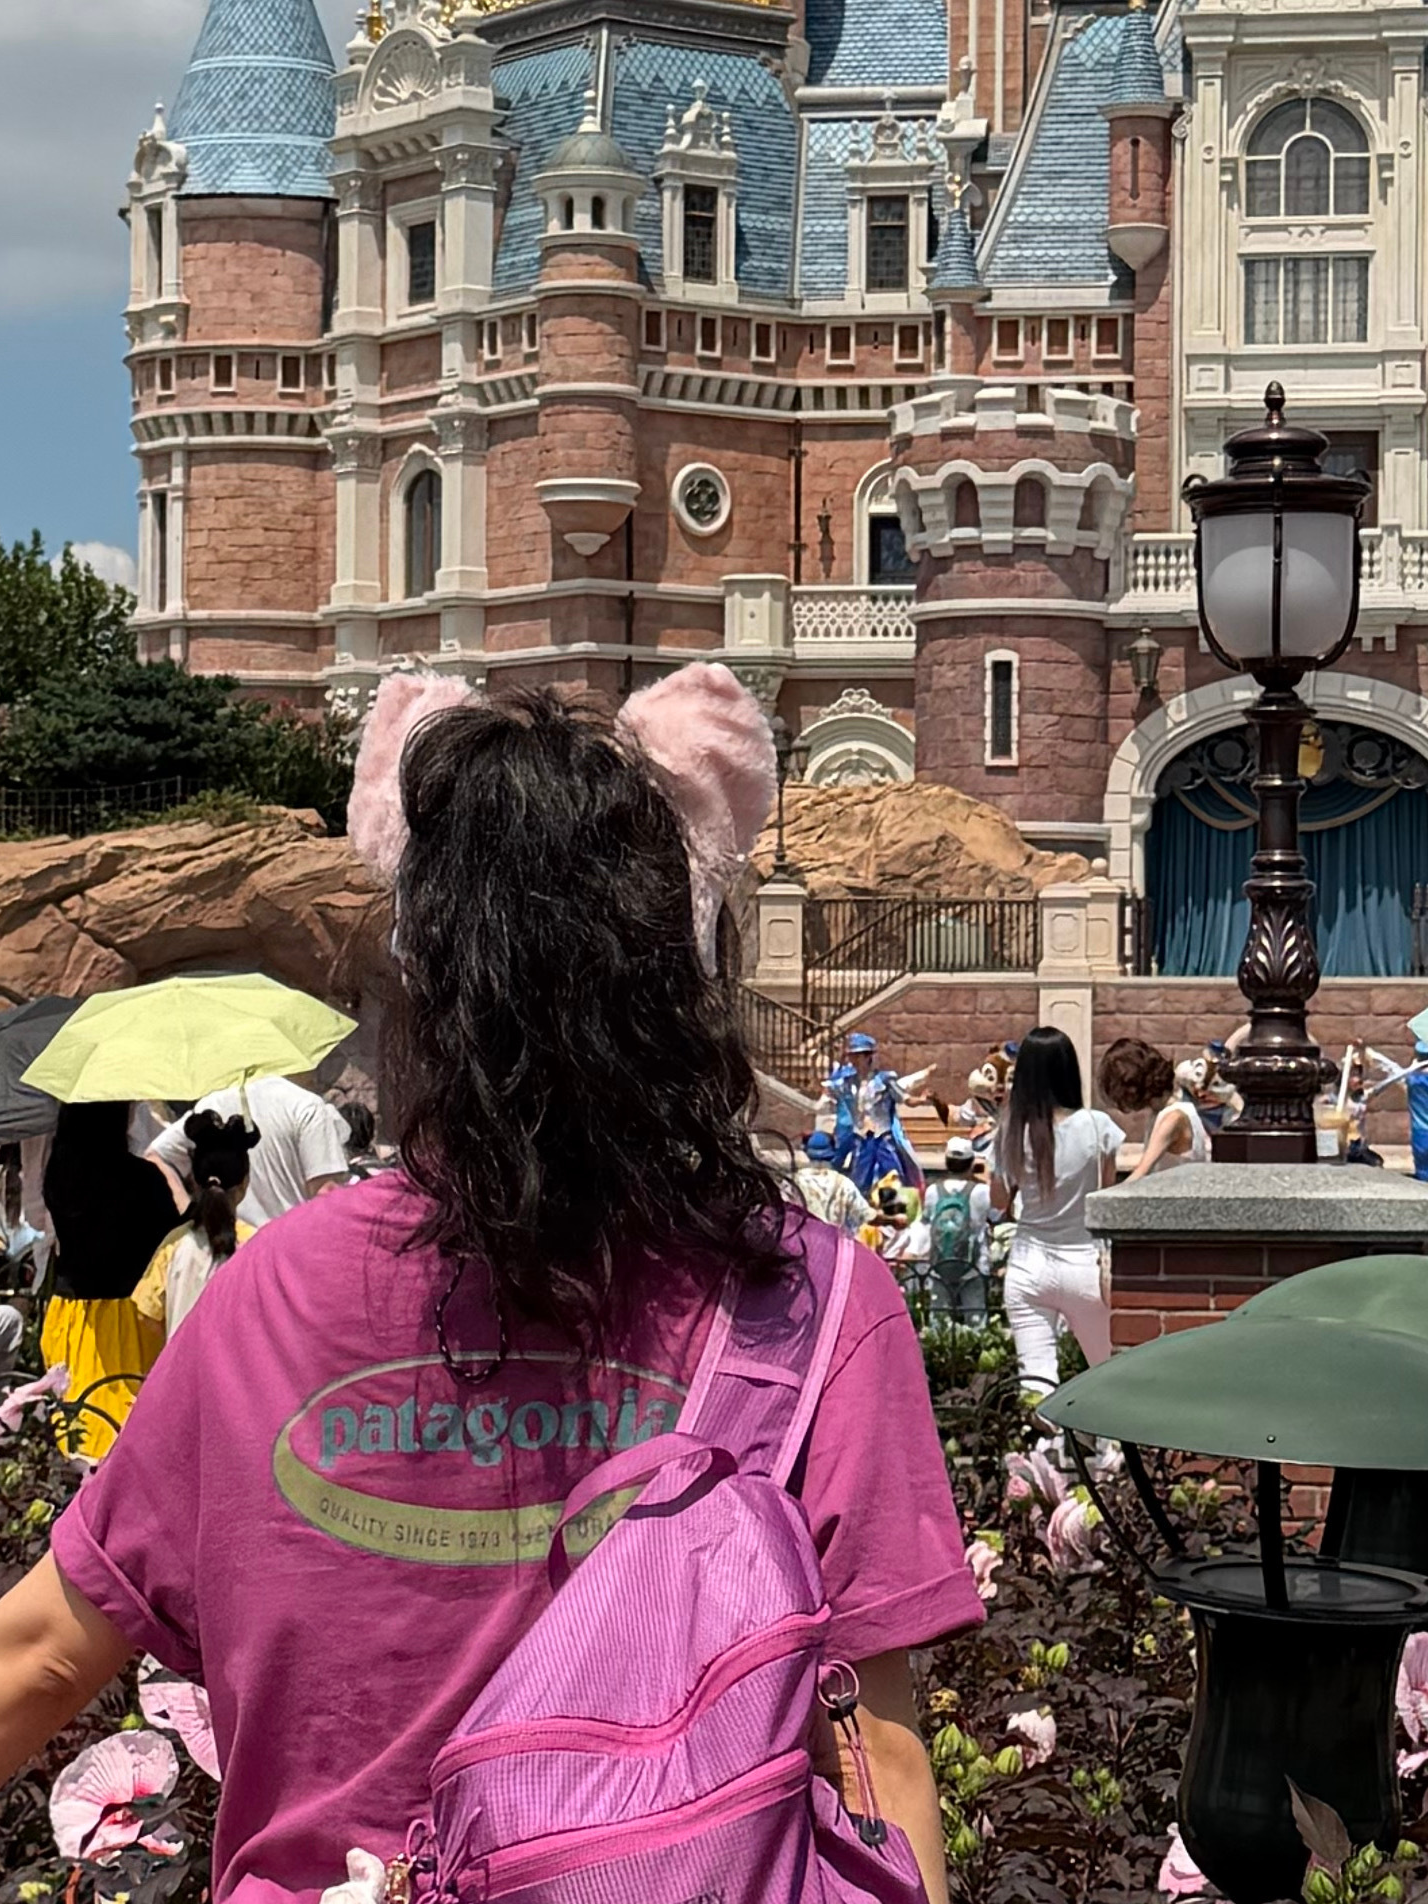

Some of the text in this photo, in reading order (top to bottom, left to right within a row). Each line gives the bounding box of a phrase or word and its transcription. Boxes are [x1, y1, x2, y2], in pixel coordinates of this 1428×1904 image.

[318, 1387, 678, 1469] patagonia
[319, 1498, 388, 1537] QUALITY
[394, 1524, 451, 1548] SINCE
[459, 1531, 500, 1549] 1973
